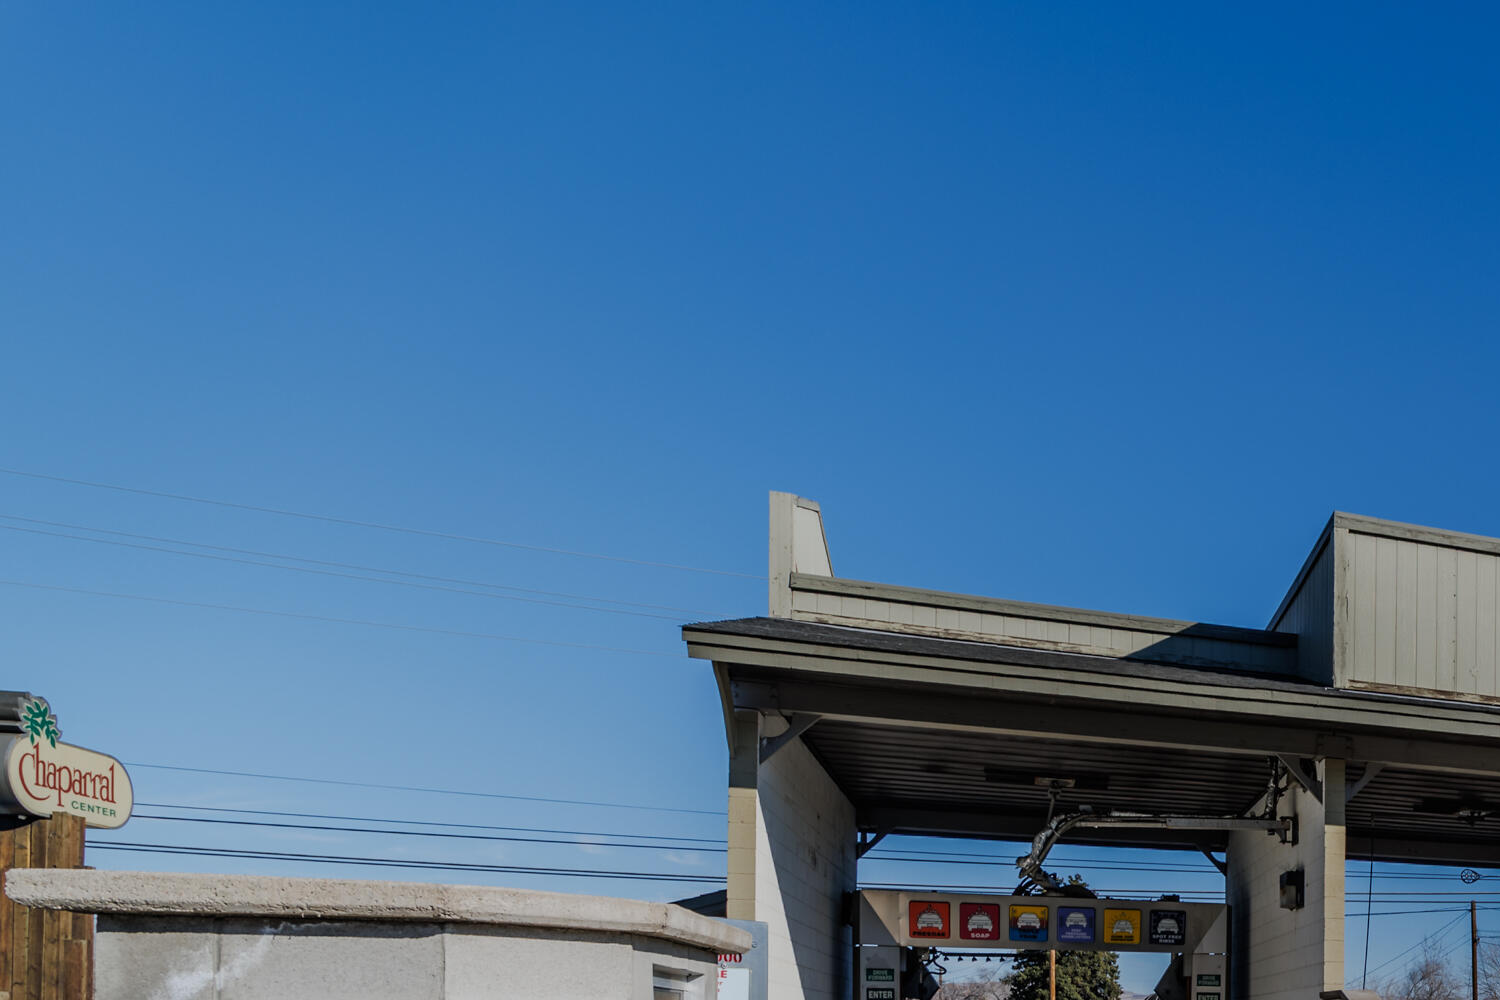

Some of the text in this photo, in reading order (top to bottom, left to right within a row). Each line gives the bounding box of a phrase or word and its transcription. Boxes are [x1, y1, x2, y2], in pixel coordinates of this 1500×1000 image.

[19, 742, 116, 807] Chaparral
[71, 801, 116, 817] CENTER
[868, 991, 893, 999] ENTER
